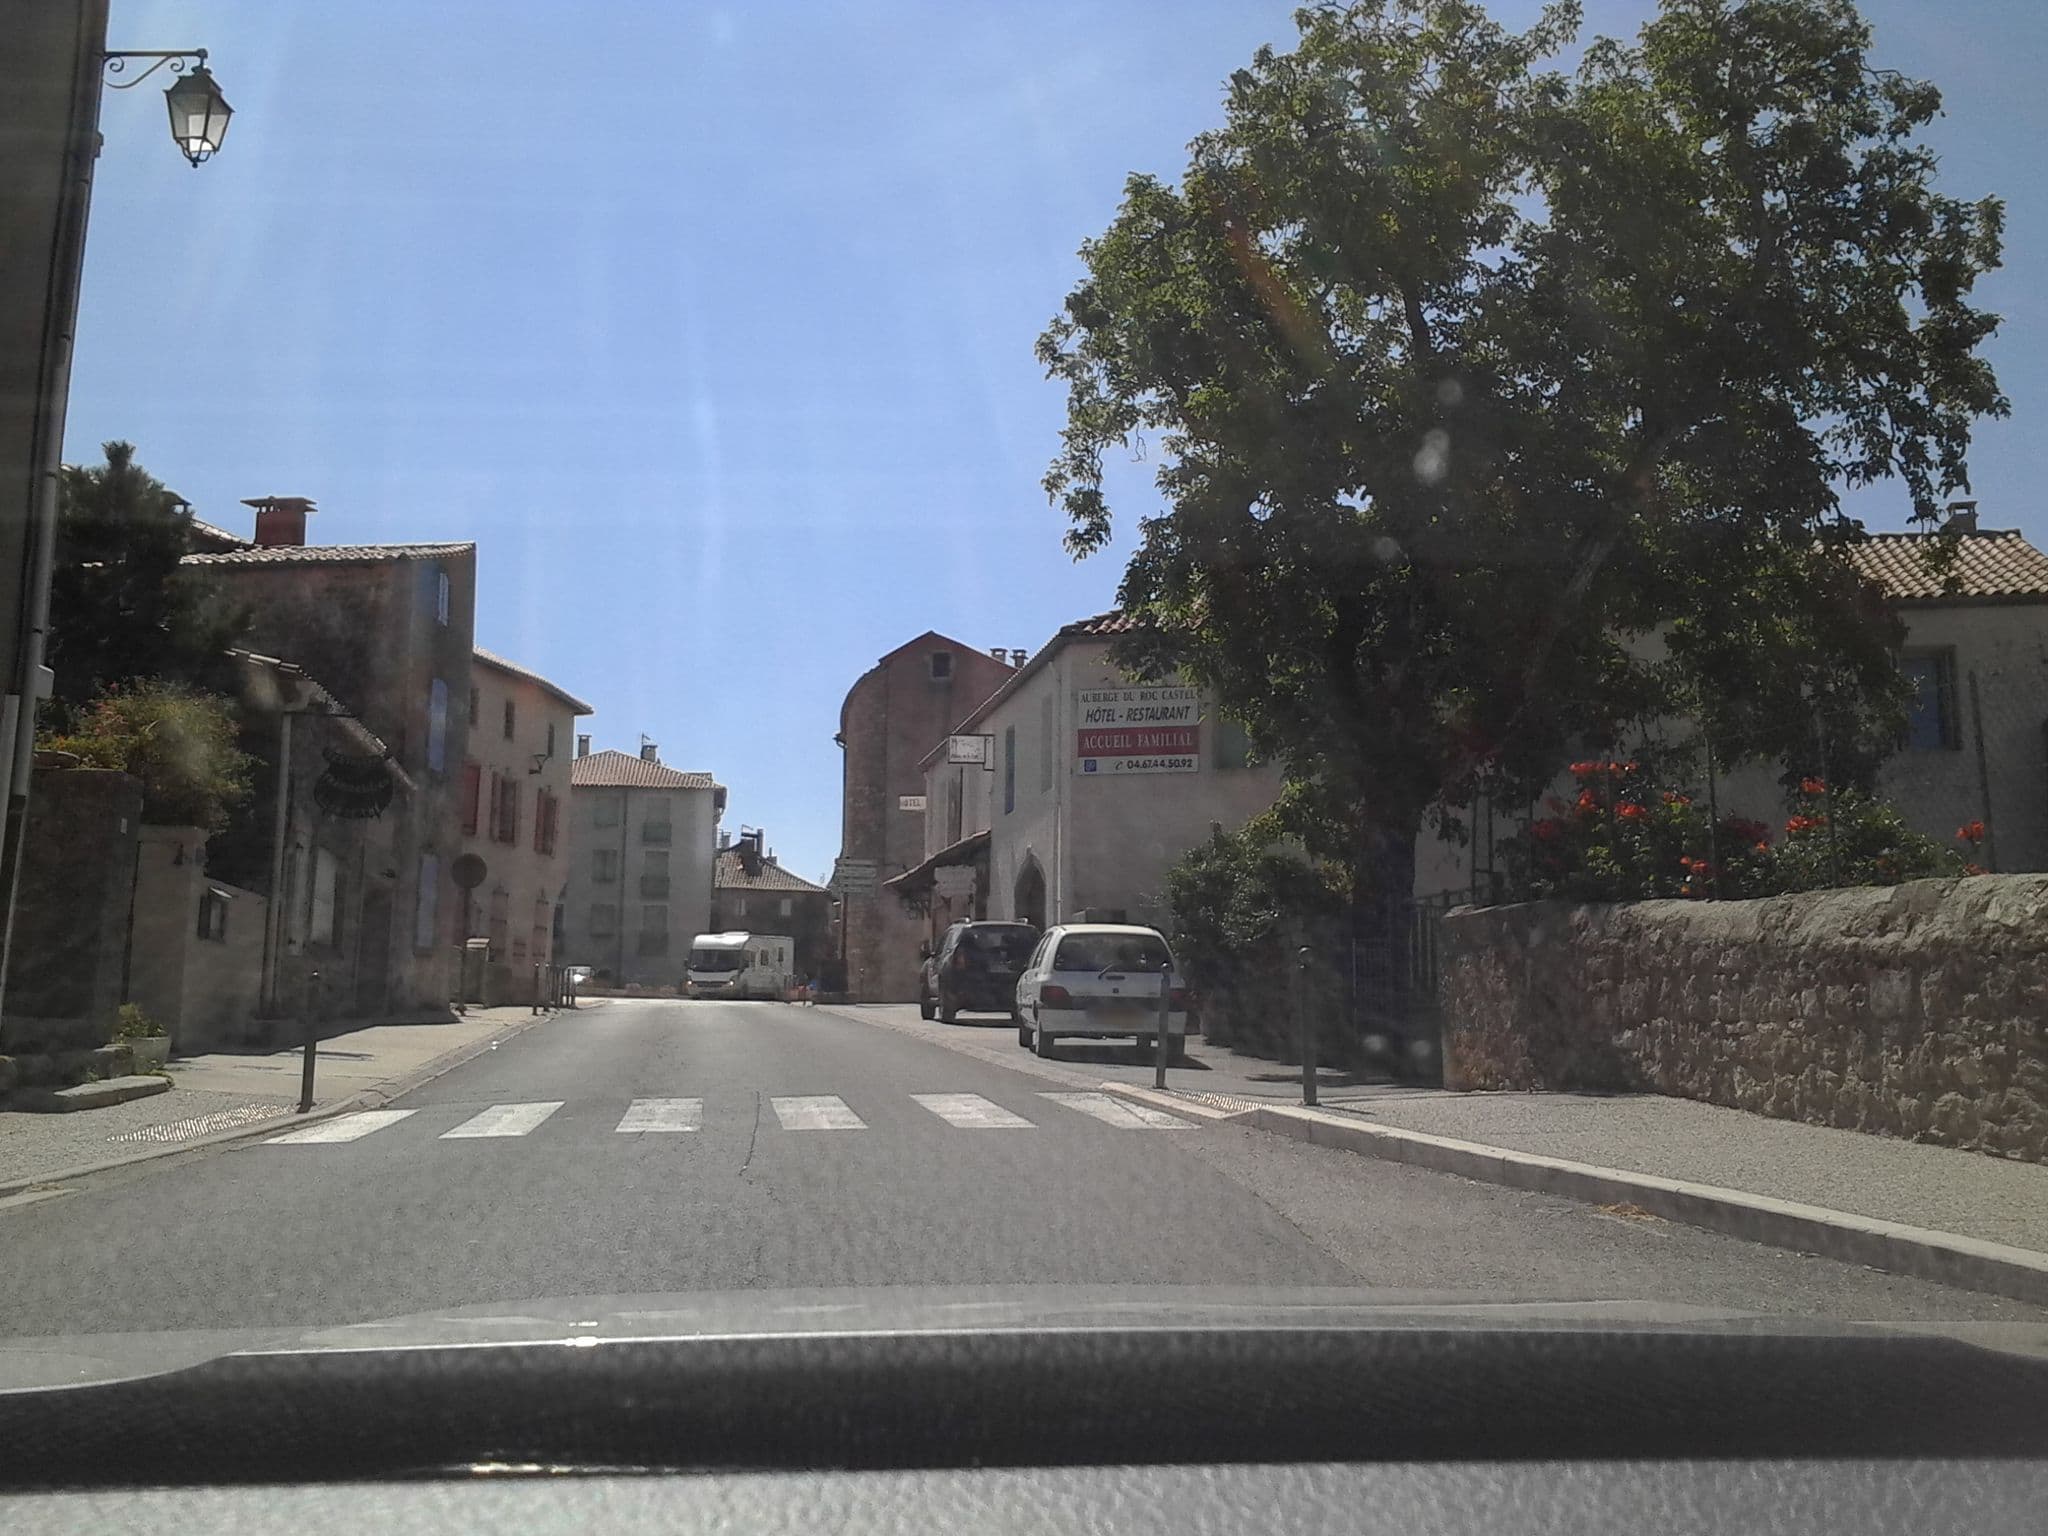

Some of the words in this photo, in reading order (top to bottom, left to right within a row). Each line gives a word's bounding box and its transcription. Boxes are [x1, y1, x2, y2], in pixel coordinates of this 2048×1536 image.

[1085, 707, 1116, 723] HÔTEL
[1126, 706, 1191, 722] RESTAURANT
[1083, 734, 1133, 749] ACCUEIL
[1137, 732, 1192, 748] FAMILIAL
